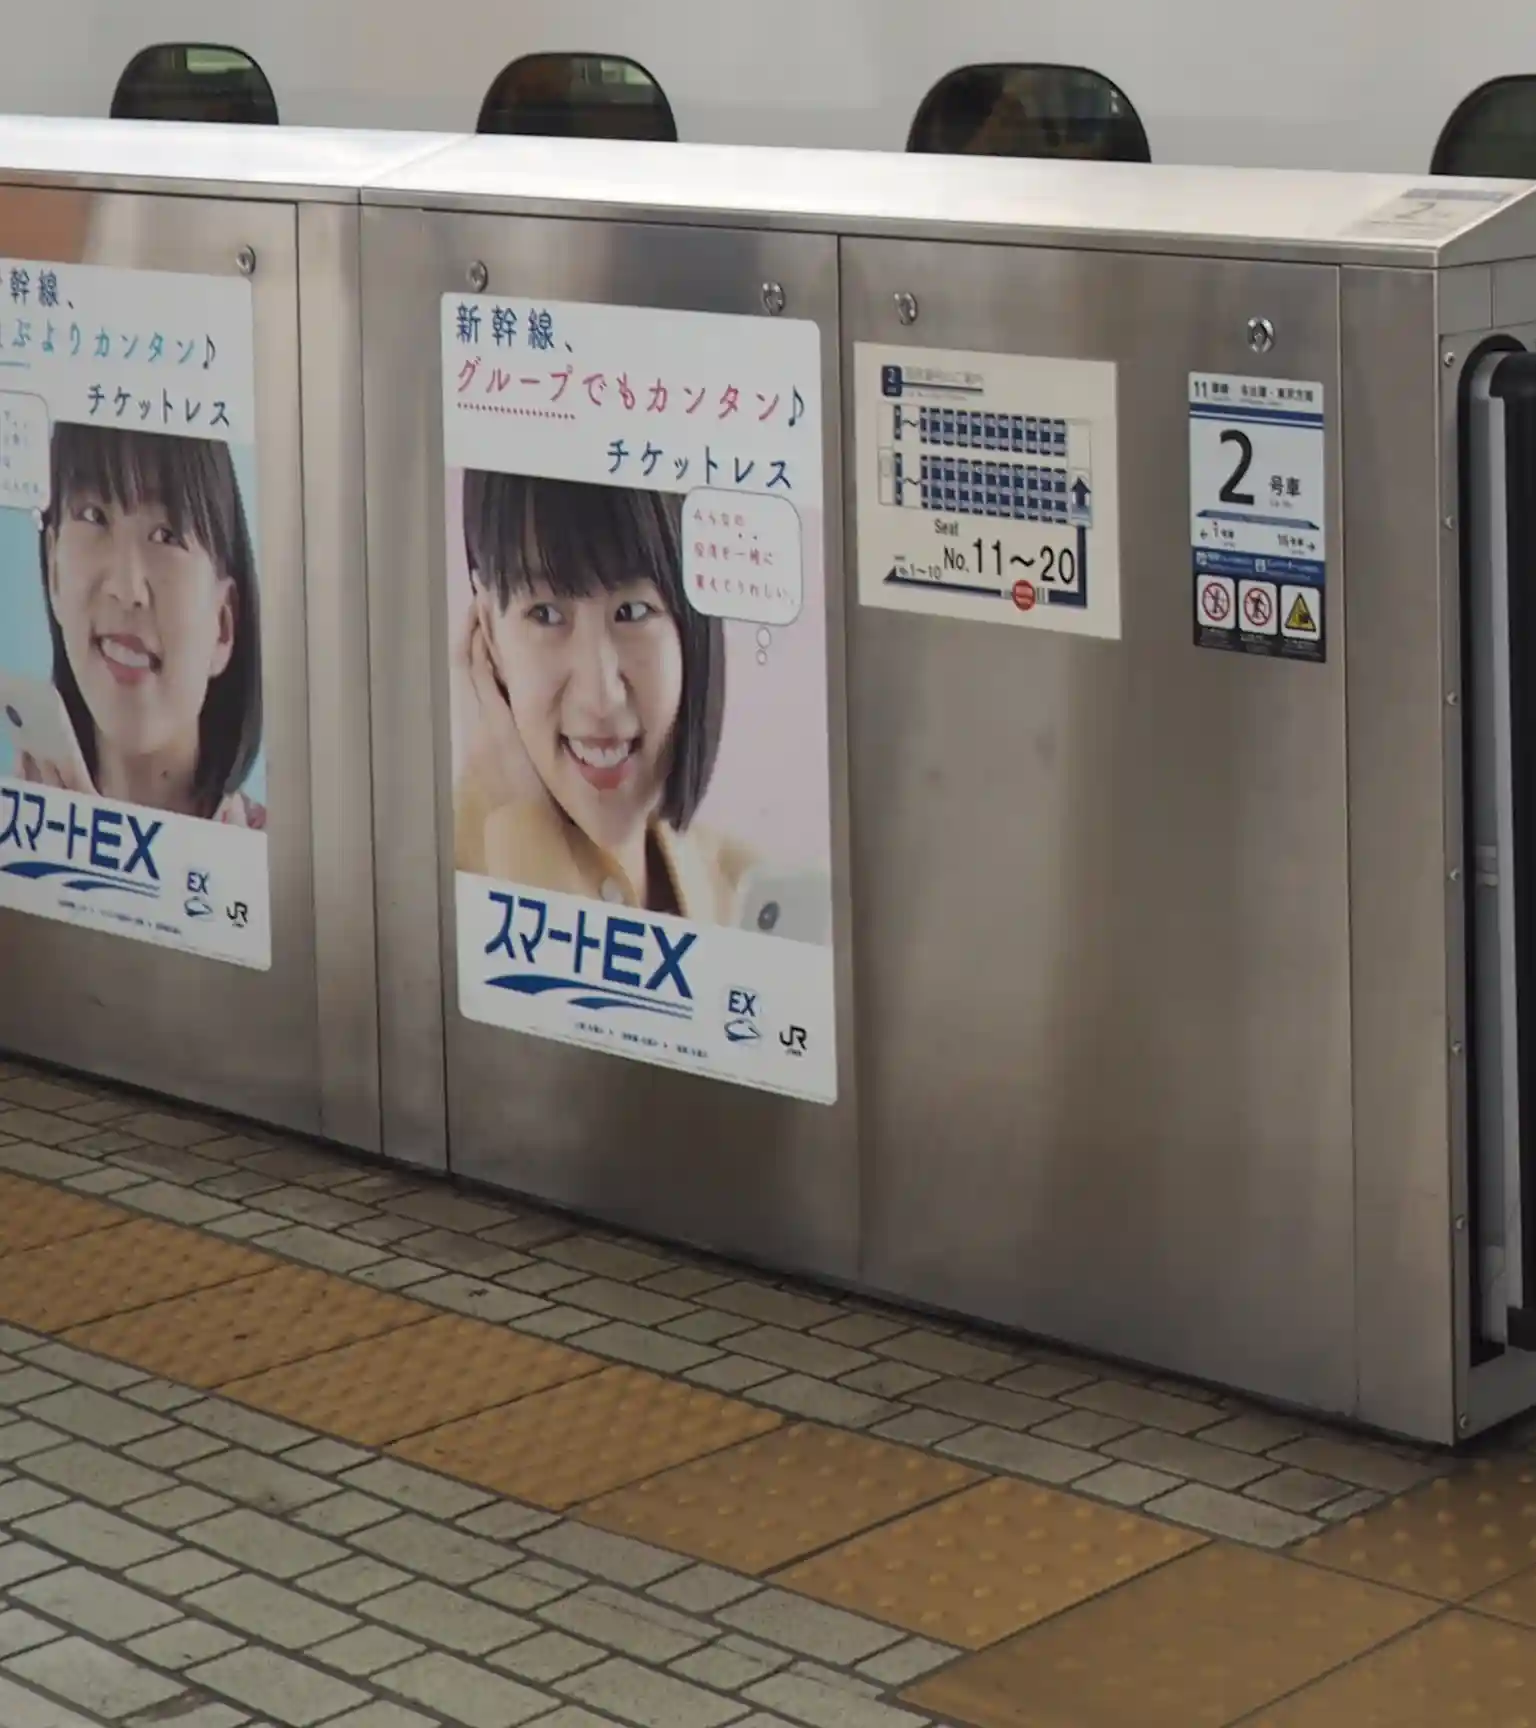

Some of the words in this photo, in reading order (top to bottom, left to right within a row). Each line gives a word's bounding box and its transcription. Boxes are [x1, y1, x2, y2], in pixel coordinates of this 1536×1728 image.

[0, 268, 74, 309] 幹線、
[455, 302, 574, 353] 新幹線、
[87, 383, 230, 428] チケットレス
[606, 438, 793, 490] チケットレス
[934, 518, 959, 538] Seat
[0, 787, 163, 881] スマートEX
[187, 870, 210, 895] EX
[226, 901, 249, 924] JR
[484, 889, 698, 1000] スマートEX
[726, 988, 757, 1018] EX
[779, 1024, 808, 1051] JR
